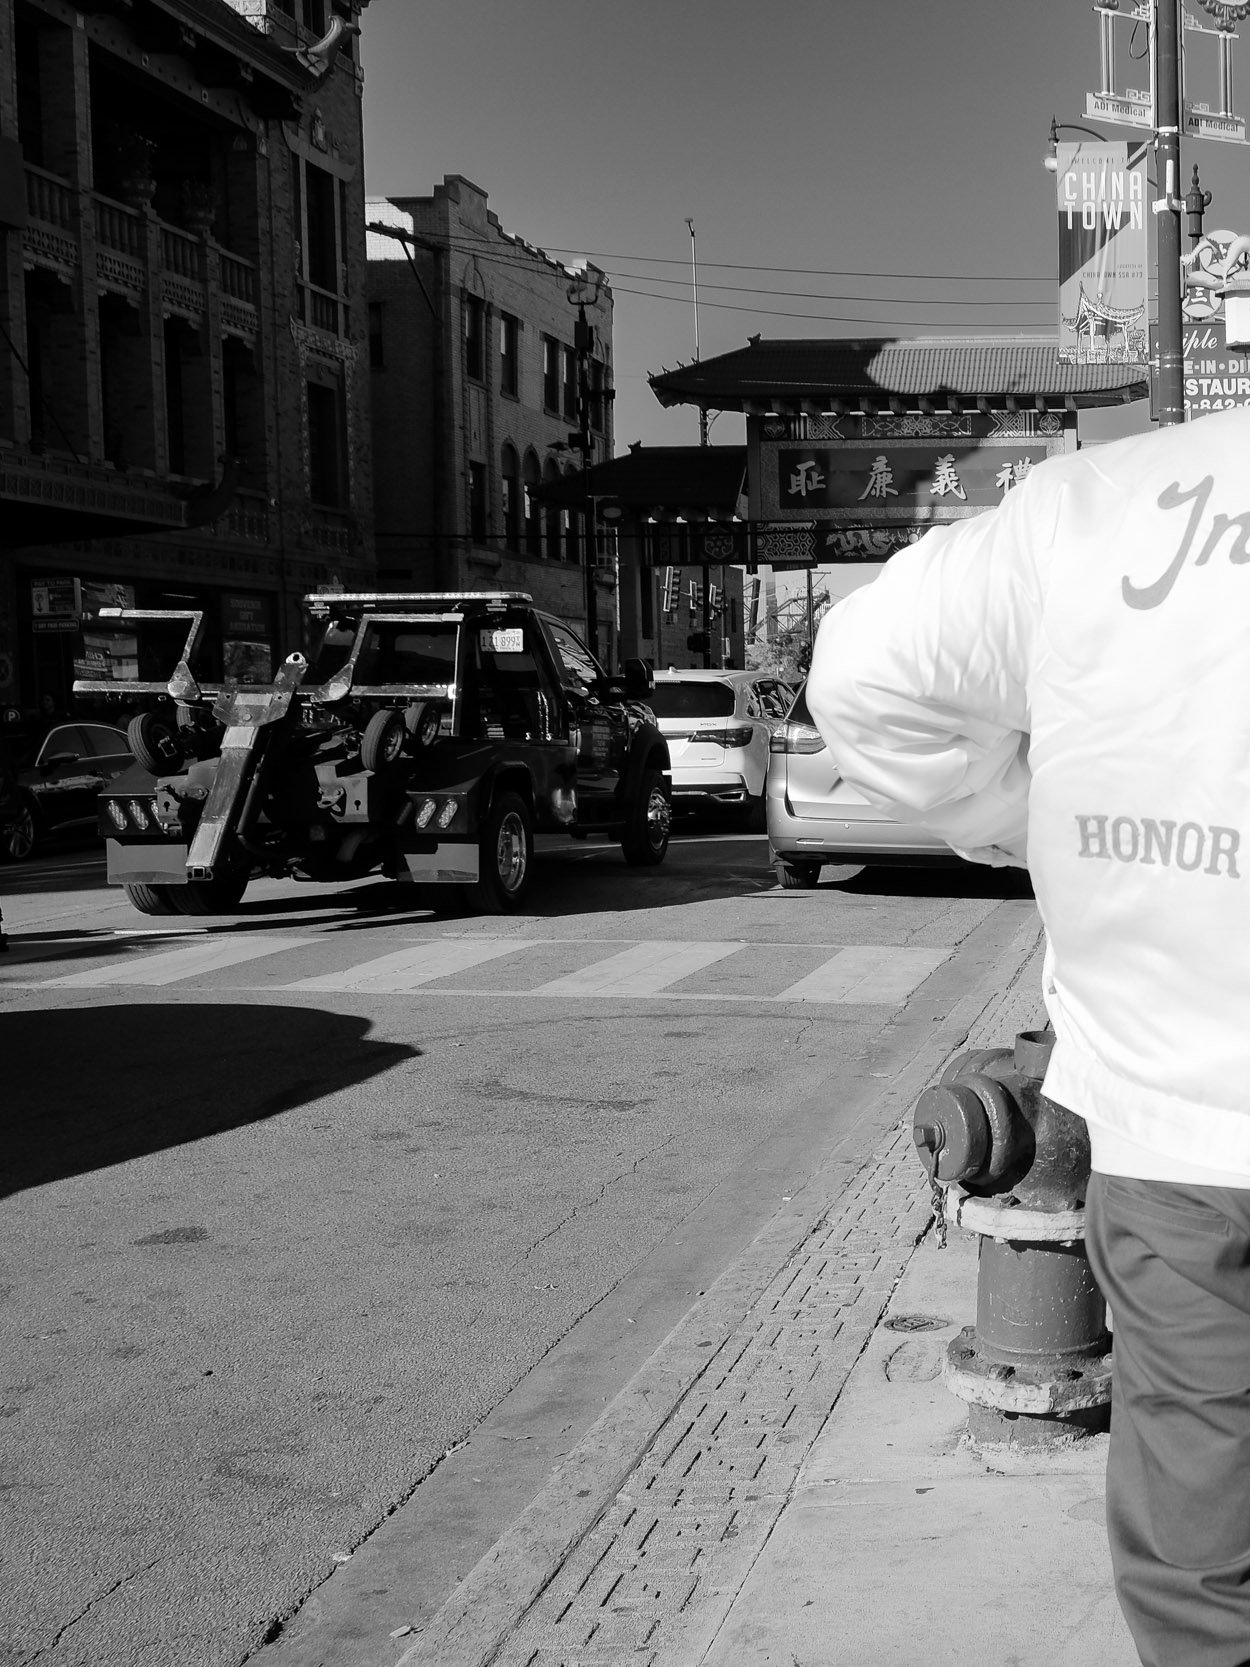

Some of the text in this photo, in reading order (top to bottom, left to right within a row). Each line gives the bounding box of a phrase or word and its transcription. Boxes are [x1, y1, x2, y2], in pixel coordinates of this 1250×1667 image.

[1094, 101, 1146, 118] ADI Medical
[1188, 117, 1239, 132] ADI Medical
[1064, 171, 1143, 201] CHINA
[1064, 201, 1143, 230] TOWN
[1184, 359, 1216, 374] E-IN
[1075, 814, 1241, 879] HONOR
